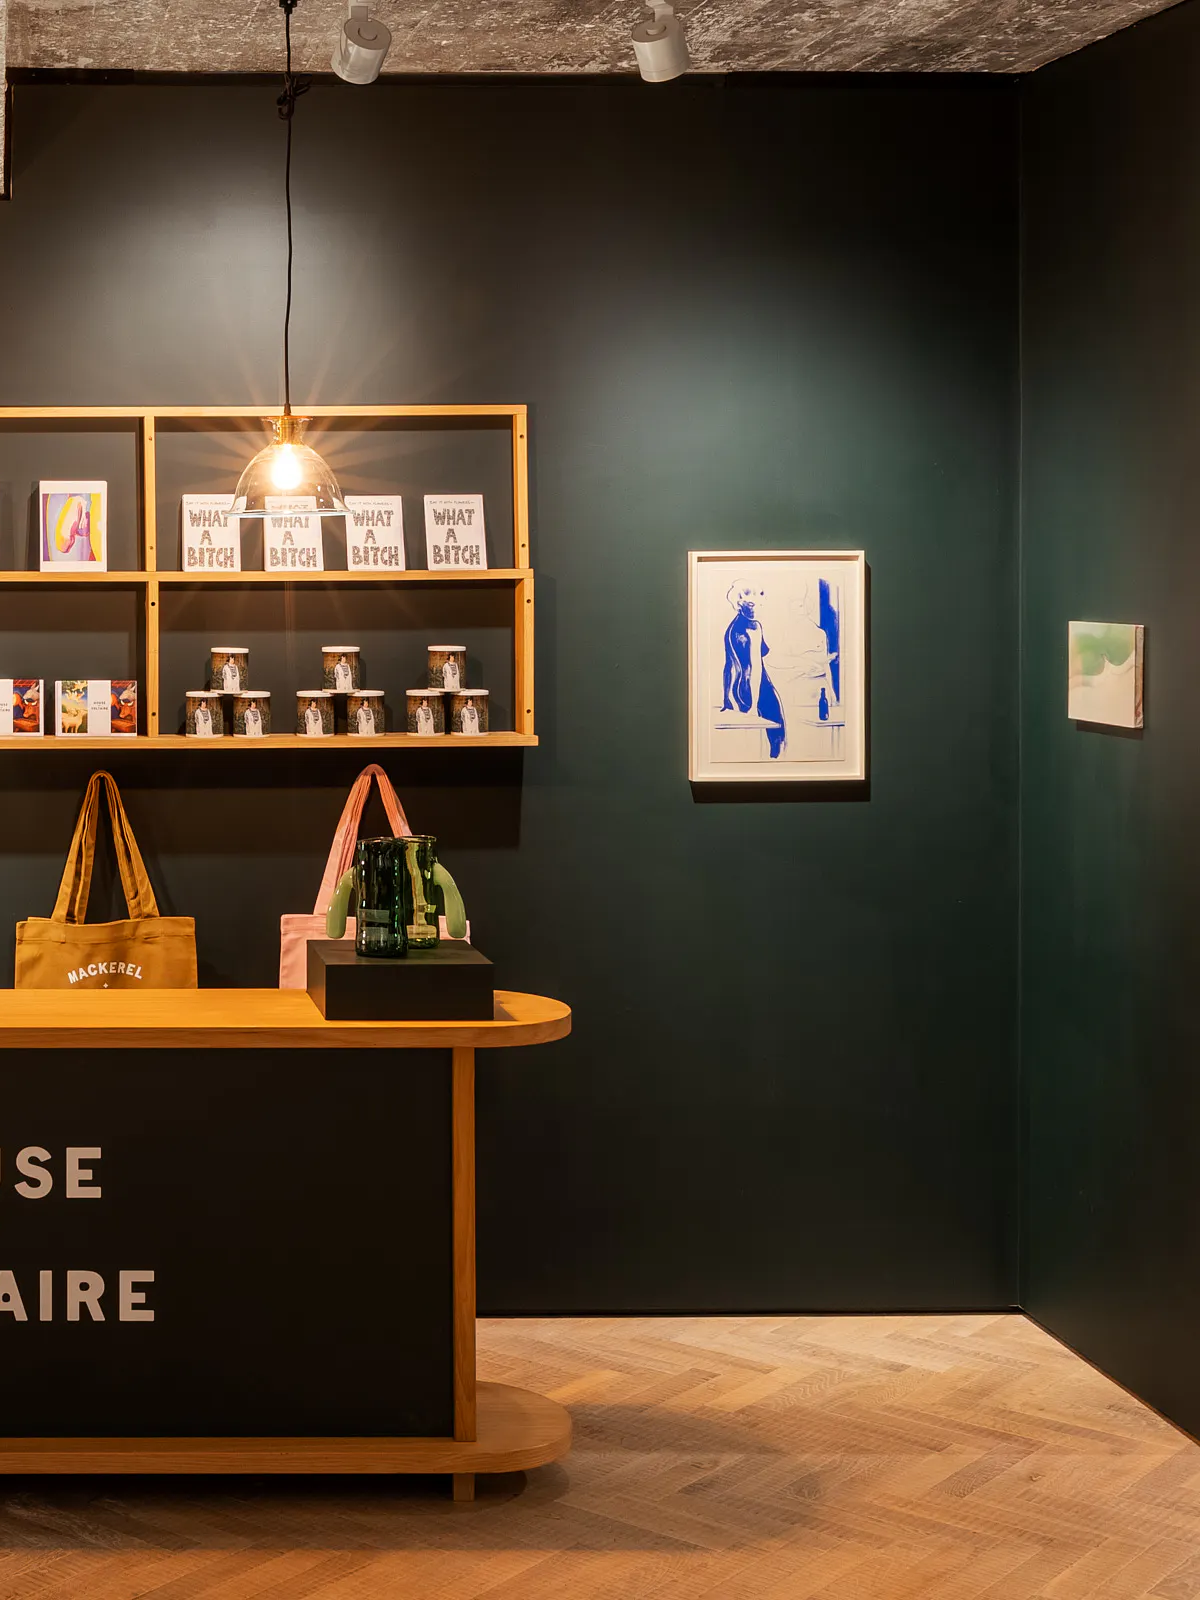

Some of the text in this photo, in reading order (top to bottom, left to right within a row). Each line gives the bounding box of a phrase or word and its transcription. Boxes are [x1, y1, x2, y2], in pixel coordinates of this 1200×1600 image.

[188, 509, 229, 527] WHAT
[351, 510, 394, 527] WHAT
[433, 508, 475, 526] WHAT
[200, 530, 212, 545] A
[282, 531, 294, 545] A
[364, 529, 376, 544] A
[445, 528, 457, 543] A
[188, 546, 234, 568] BITCH
[270, 547, 317, 568] BITCH
[352, 546, 399, 566] BITCH
[433, 545, 480, 565] BITCH
[66, 961, 143, 984] MACKEREL
